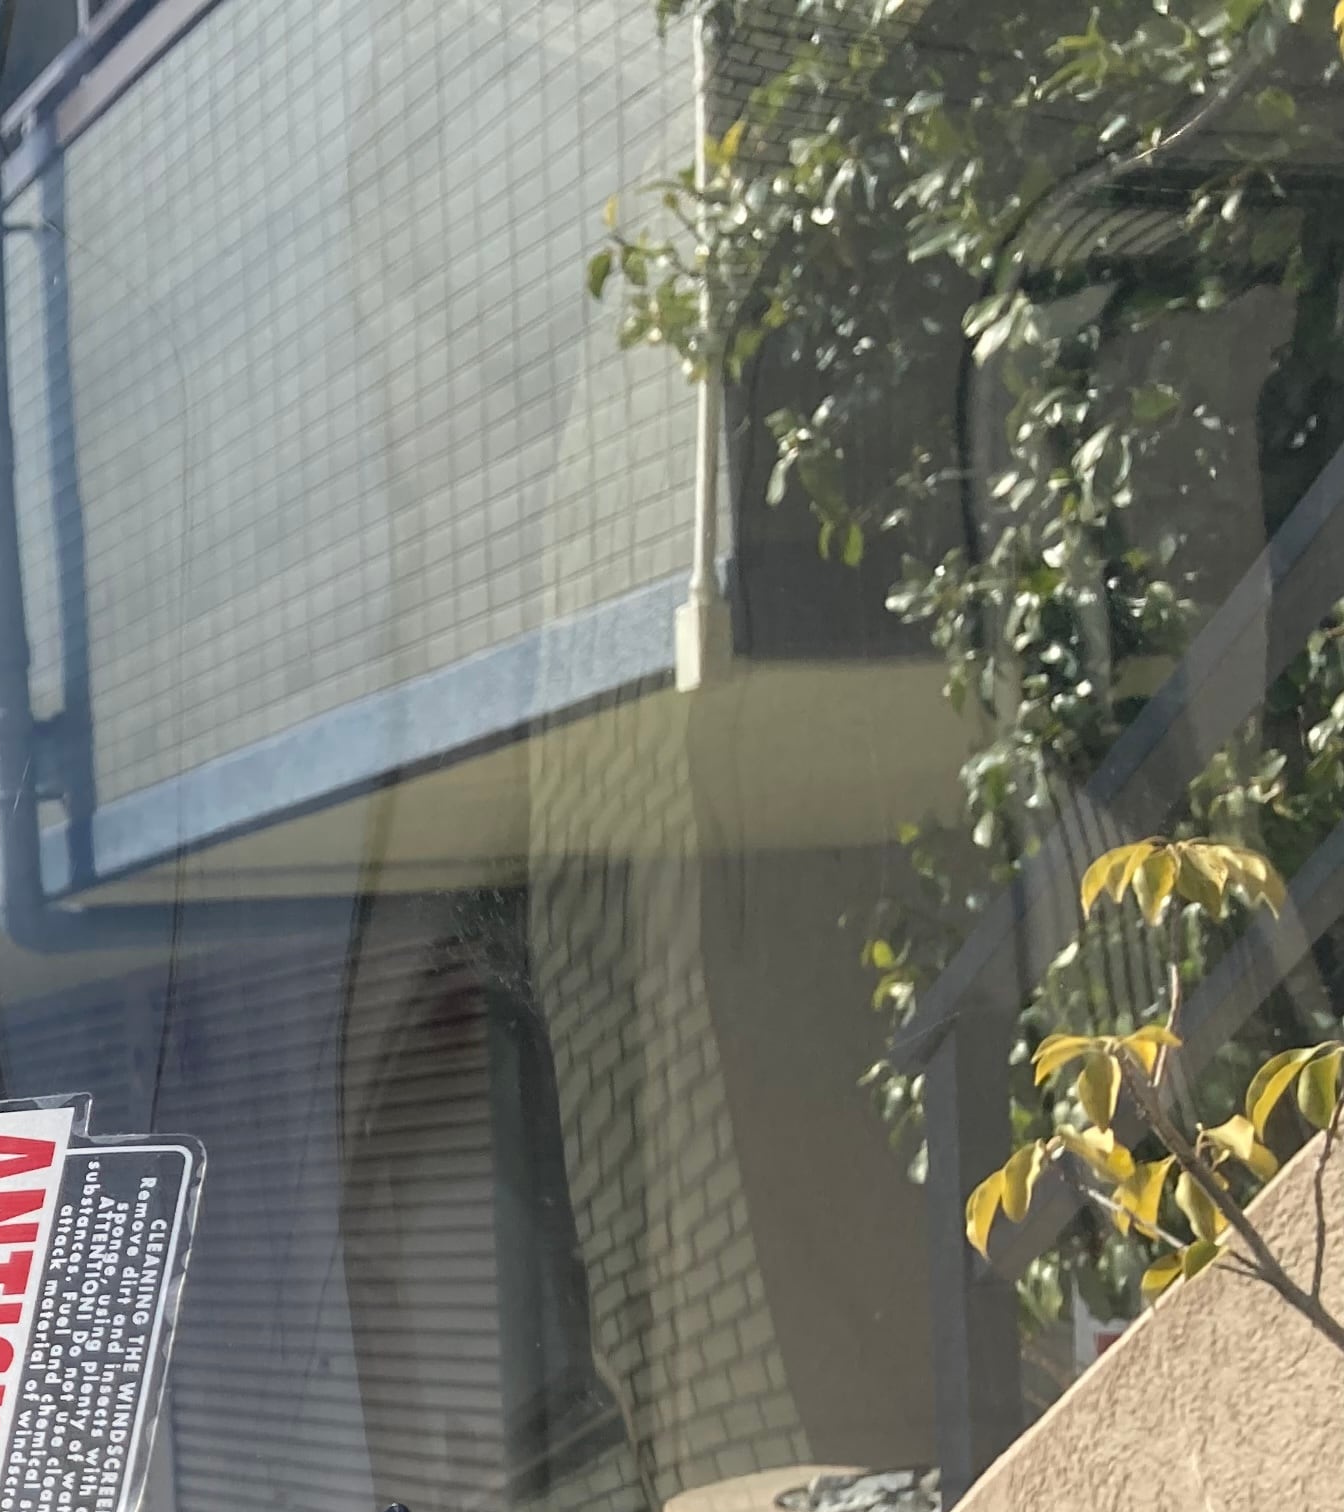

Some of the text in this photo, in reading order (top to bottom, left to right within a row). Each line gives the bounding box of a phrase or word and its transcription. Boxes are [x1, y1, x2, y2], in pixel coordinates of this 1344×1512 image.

[47, 1203, 74, 1271] attack
[63, 1159, 102, 1282] substances.
[125, 1176, 158, 1257] Remove
[115, 1264, 140, 1305] dirt
[130, 1217, 168, 1326] CLEANING
[27, 1278, 59, 1370] material
[53, 1290, 79, 1335] Fuel
[83, 1293, 112, 1352] using
[105, 1312, 127, 1354] and
[43, 1343, 64, 1384] and
[66, 1328, 90, 1358] Do
[121, 1333, 146, 1373] THE
[21, 1378, 41, 1402] of
[56, 1365, 78, 1402] not
[68, 1360, 101, 1432] plenty
[89, 1362, 122, 1438] insects
[22, 1392, 58, 1489] chemical
[49, 1410, 70, 1448] use
[65, 1438, 85, 1463] of
[77, 1446, 102, 1497] with
